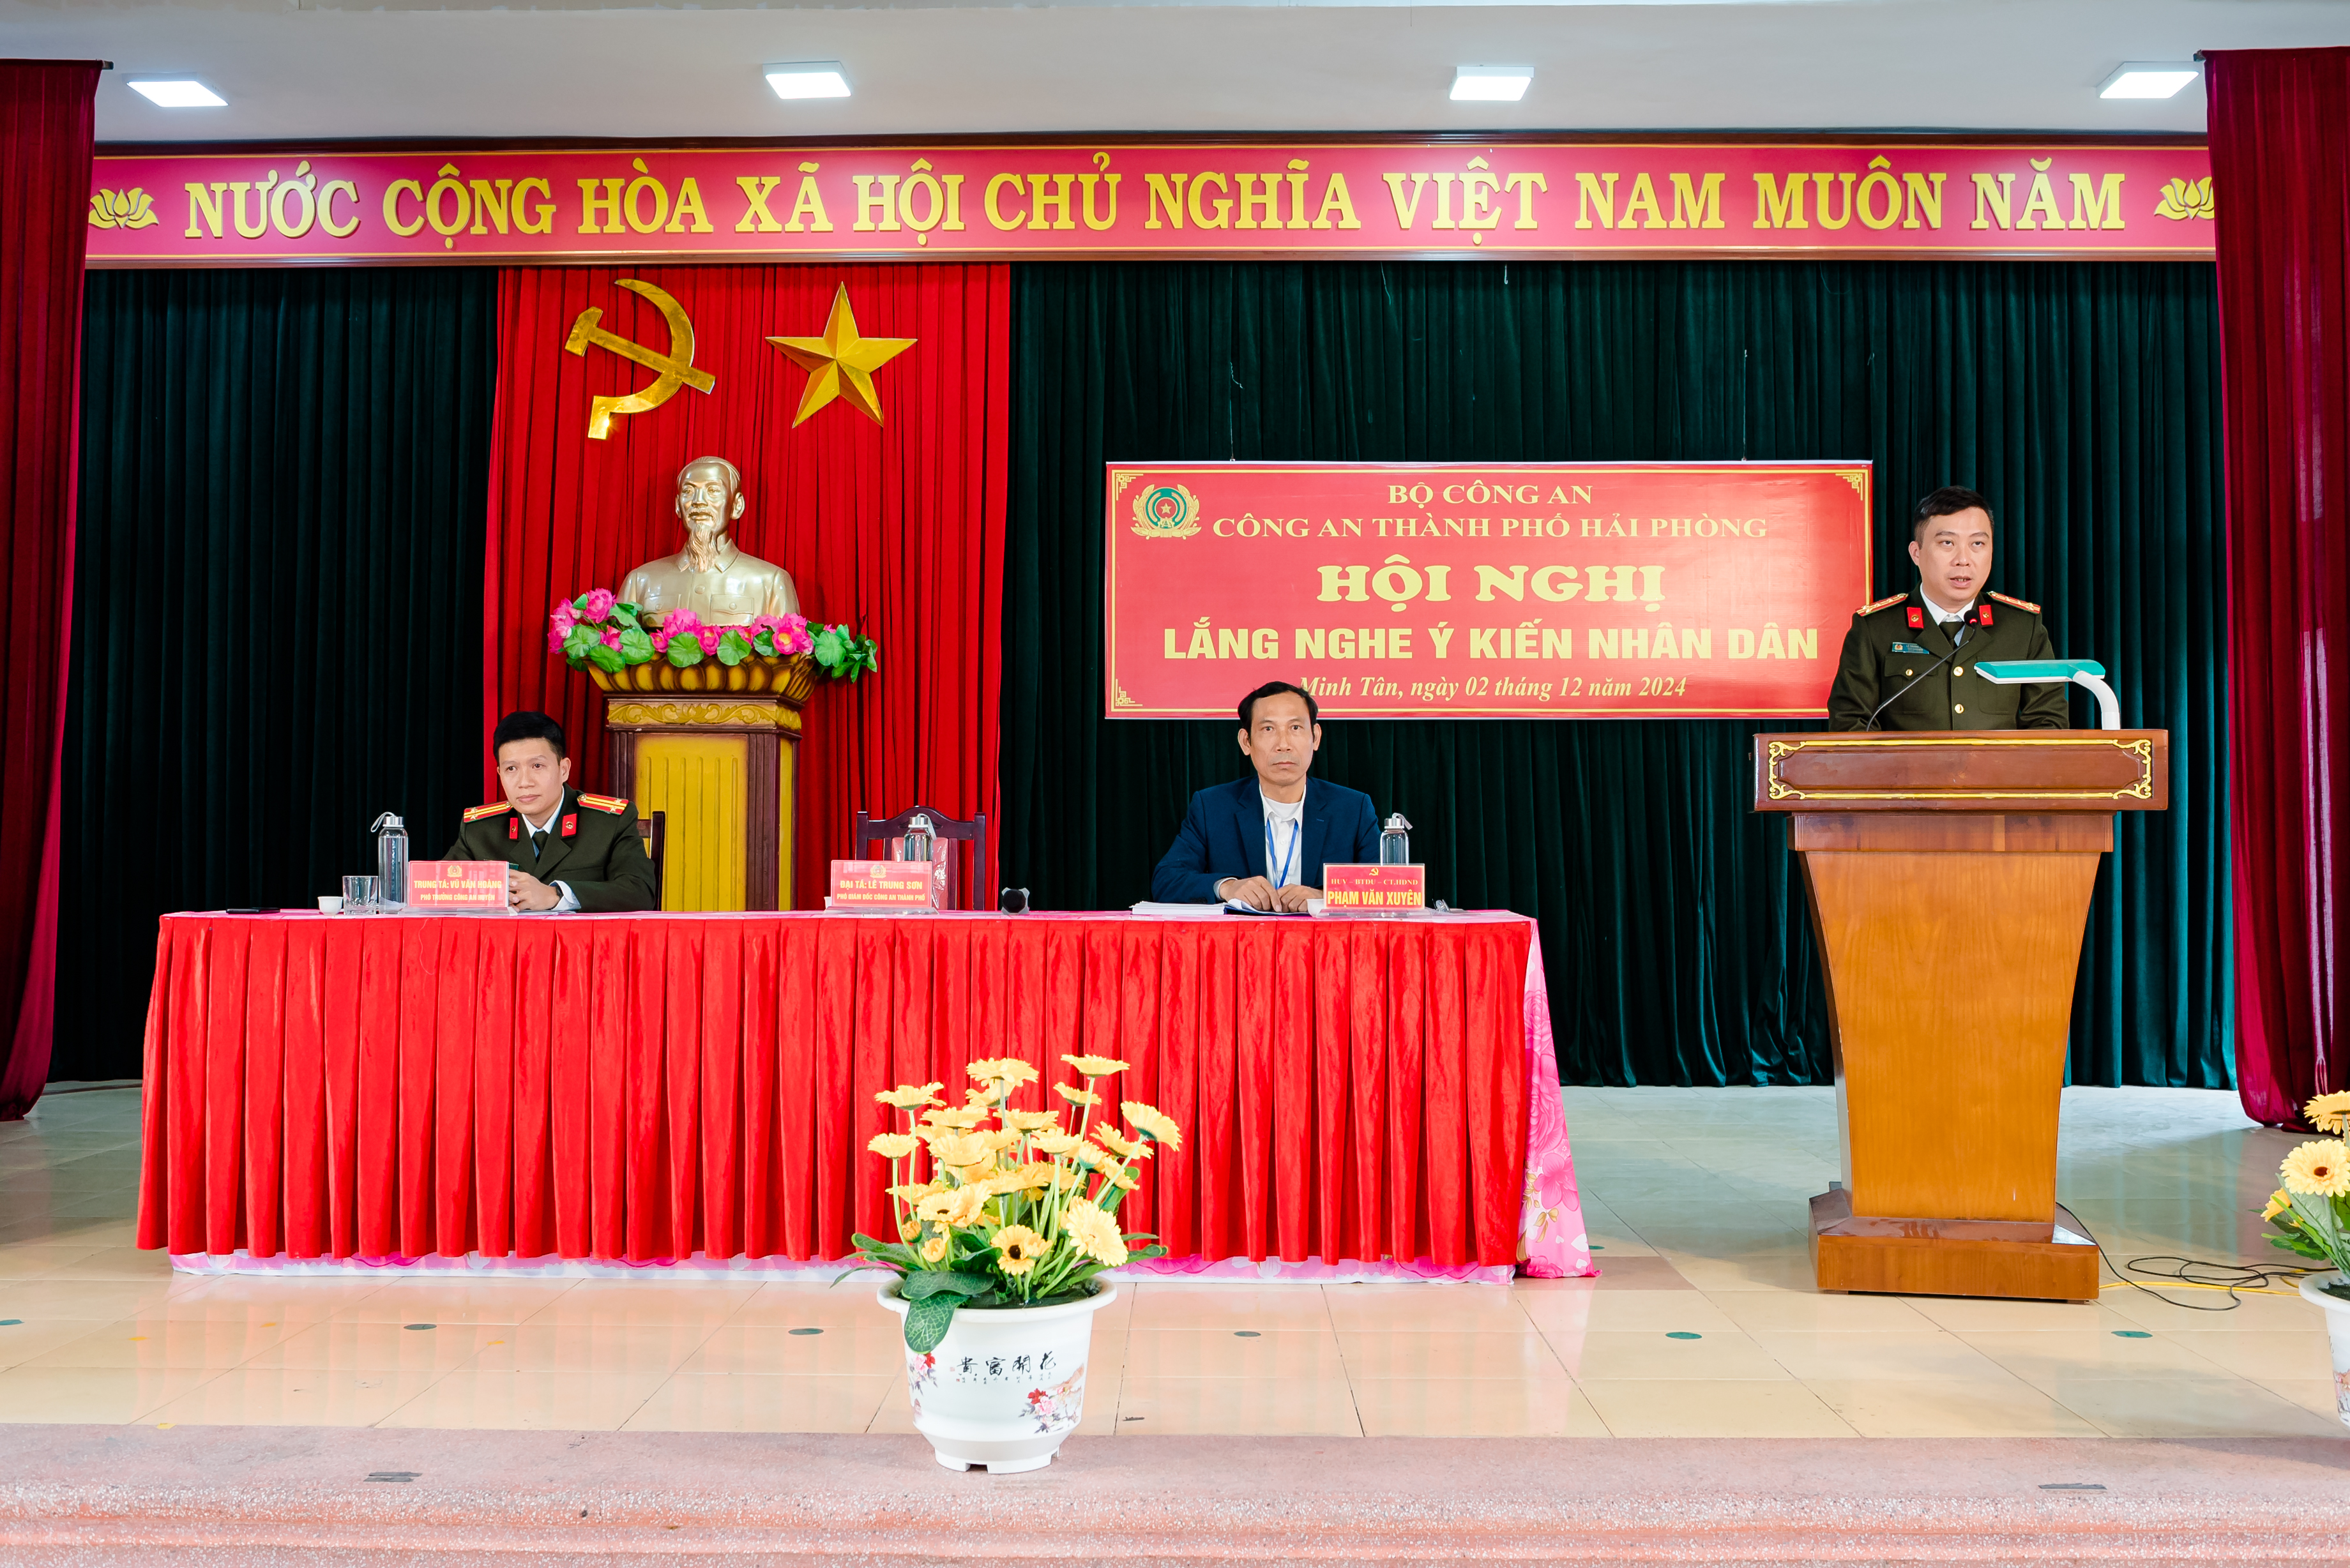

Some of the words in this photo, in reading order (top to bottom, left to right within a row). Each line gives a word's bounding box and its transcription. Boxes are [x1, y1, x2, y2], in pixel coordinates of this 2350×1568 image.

[184, 160, 361, 239] NƯỚC
[383, 162, 556, 249] CỘNG
[578, 158, 713, 234] HÒA
[735, 162, 833, 233] XÃ
[853, 158, 965, 245] HỘI
[984, 151, 1122, 231] CHỦ
[1146, 159, 1361, 230] NGHĨA
[1383, 155, 1548, 245] VIỆT
[1575, 172, 1725, 230] NAM
[1753, 154, 1946, 231] MUÔN
[1972, 158, 2125, 230] NĂM
[1388, 482, 1434, 509] BỘ
[1443, 479, 1540, 504] CÔNG
[1547, 485, 1593, 504] AN
[1213, 513, 1310, 538] CÔNG
[1318, 518, 1363, 538] AN
[1372, 513, 1491, 538] THÀNH
[1501, 513, 1570, 538] PHỐ
[1580, 513, 1639, 538] HẢI
[1651, 513, 1768, 538] PHÒNG
[1317, 554, 1452, 612] HỘI
[1474, 565, 1665, 612] NGHỊ
[1164, 616, 1278, 659] LẮNG
[1295, 628, 1413, 659] NGHE
[1428, 621, 1455, 659] Ý
[1469, 618, 1572, 659] KIẾN
[1589, 622, 1711, 659] NHÂN
[1728, 622, 1818, 659] DÂN
[1300, 676, 1351, 697] Minh
[1360, 676, 1404, 700] Tân,
[1410, 677, 1459, 701] ngày
[1465, 677, 1489, 697] 02
[1494, 677, 1553, 701] tháng
[1559, 677, 1582, 697] 12
[1588, 677, 1632, 697] năm
[1639, 677, 1687, 697] 2024
[414, 880, 437, 889] TRUNG
[438, 879, 450, 889] TÁ:
[450, 879, 460, 889] VŨ
[461, 879, 476, 889] VĂN
[477, 879, 502, 889] HOÀNG
[840, 880, 853, 890] ĐẠI
[855, 879, 867, 889] TÁ:
[868, 880, 877, 889] LÊ
[879, 881, 904, 889] TRUNG
[906, 880, 923, 889] SƠN
[862, 892, 873, 900] ĐỐC
[914, 893, 925, 901] PHỐ
[432, 892, 453, 901] TRƯỞNG
[478, 893, 496, 902] HUYỆN
[1328, 891, 1359, 907] PHẠM
[1362, 889, 1383, 905] VĂN
[1386, 889, 1421, 905] XUYÊN
